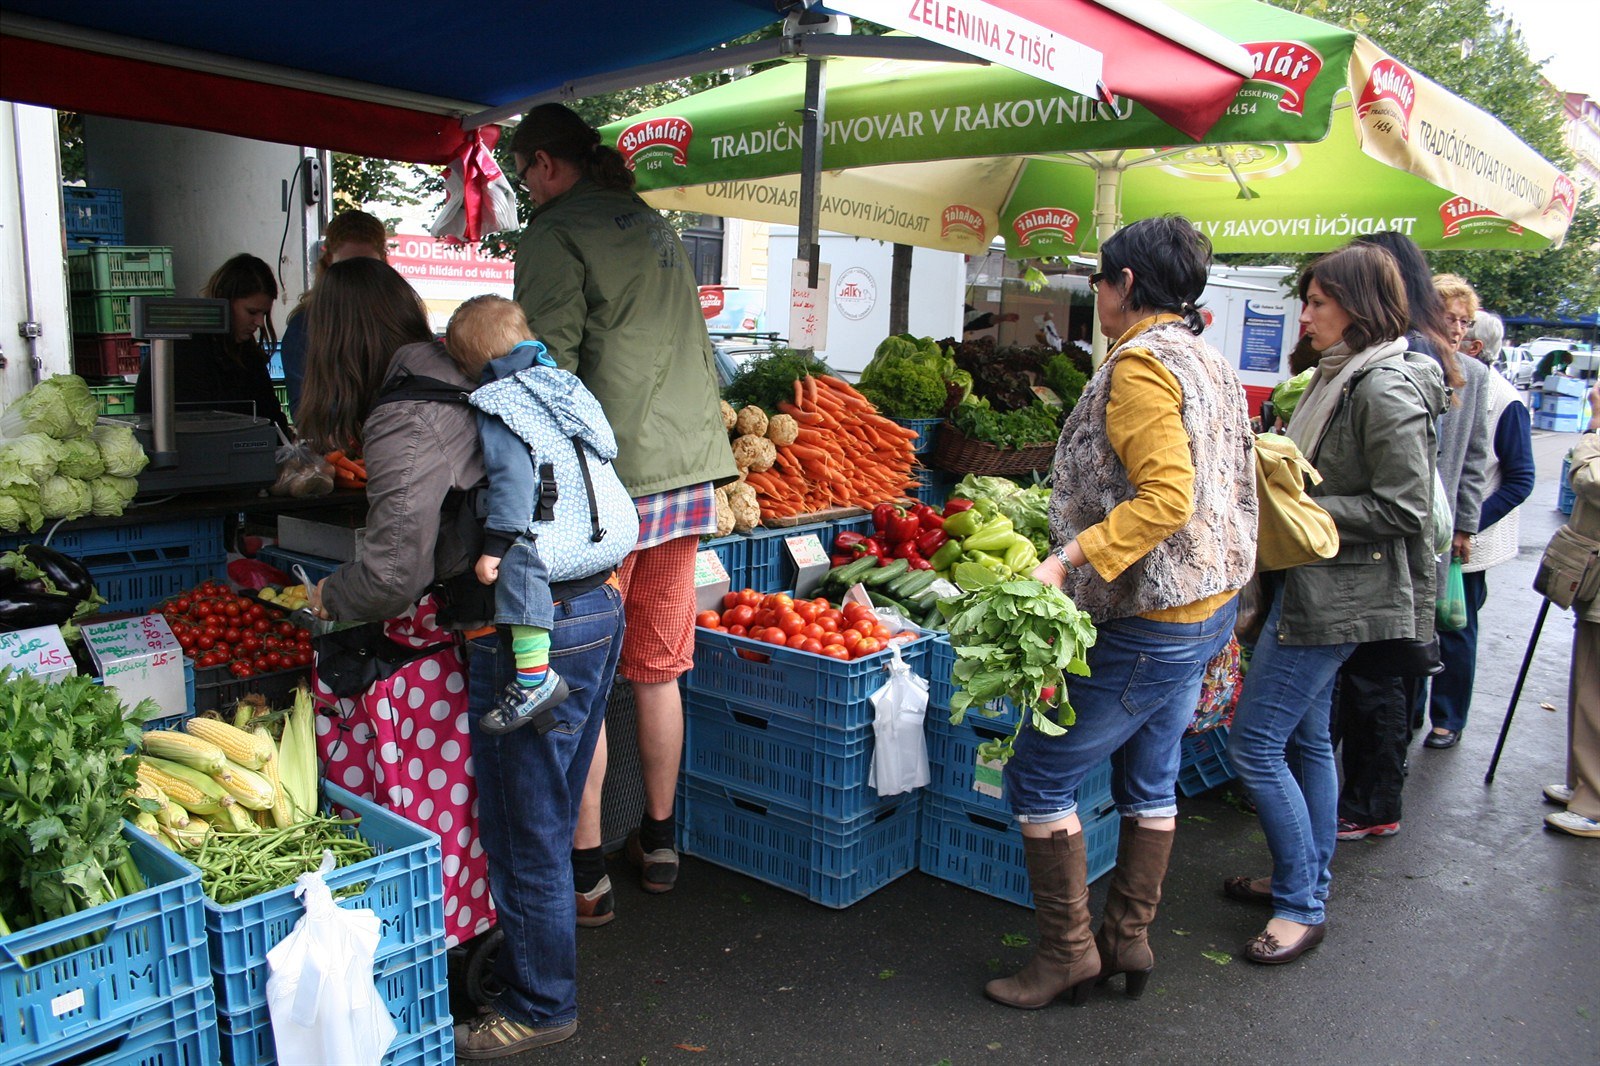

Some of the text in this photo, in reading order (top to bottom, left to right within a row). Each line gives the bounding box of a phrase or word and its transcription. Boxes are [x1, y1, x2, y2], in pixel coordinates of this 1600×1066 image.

[1004, 29, 1015, 56] Z
[1018, 34, 1056, 71] TIŠIC
[1251, 46, 1312, 80] alář
[1240, 89, 1262, 98] ČESKÉ
[1262, 91, 1279, 101] PIVO
[1226, 103, 1257, 116] 1454
[622, 120, 688, 151] Bakalář
[710, 121, 803, 160] TRADIČN
[930, 107, 950, 134] V
[1373, 120, 1393, 134] 1454
[1420, 120, 1468, 166] TRADIČNÍ
[1462, 143, 1500, 185] PIVOVAR
[646, 160, 662, 170] 1454
[386, 239, 472, 262] ELODENNÍ
[429, 265, 463, 278] hlídání
[465, 268, 478, 278] od
[480, 268, 503, 280] věku
[839, 282, 862, 298] JATKY
